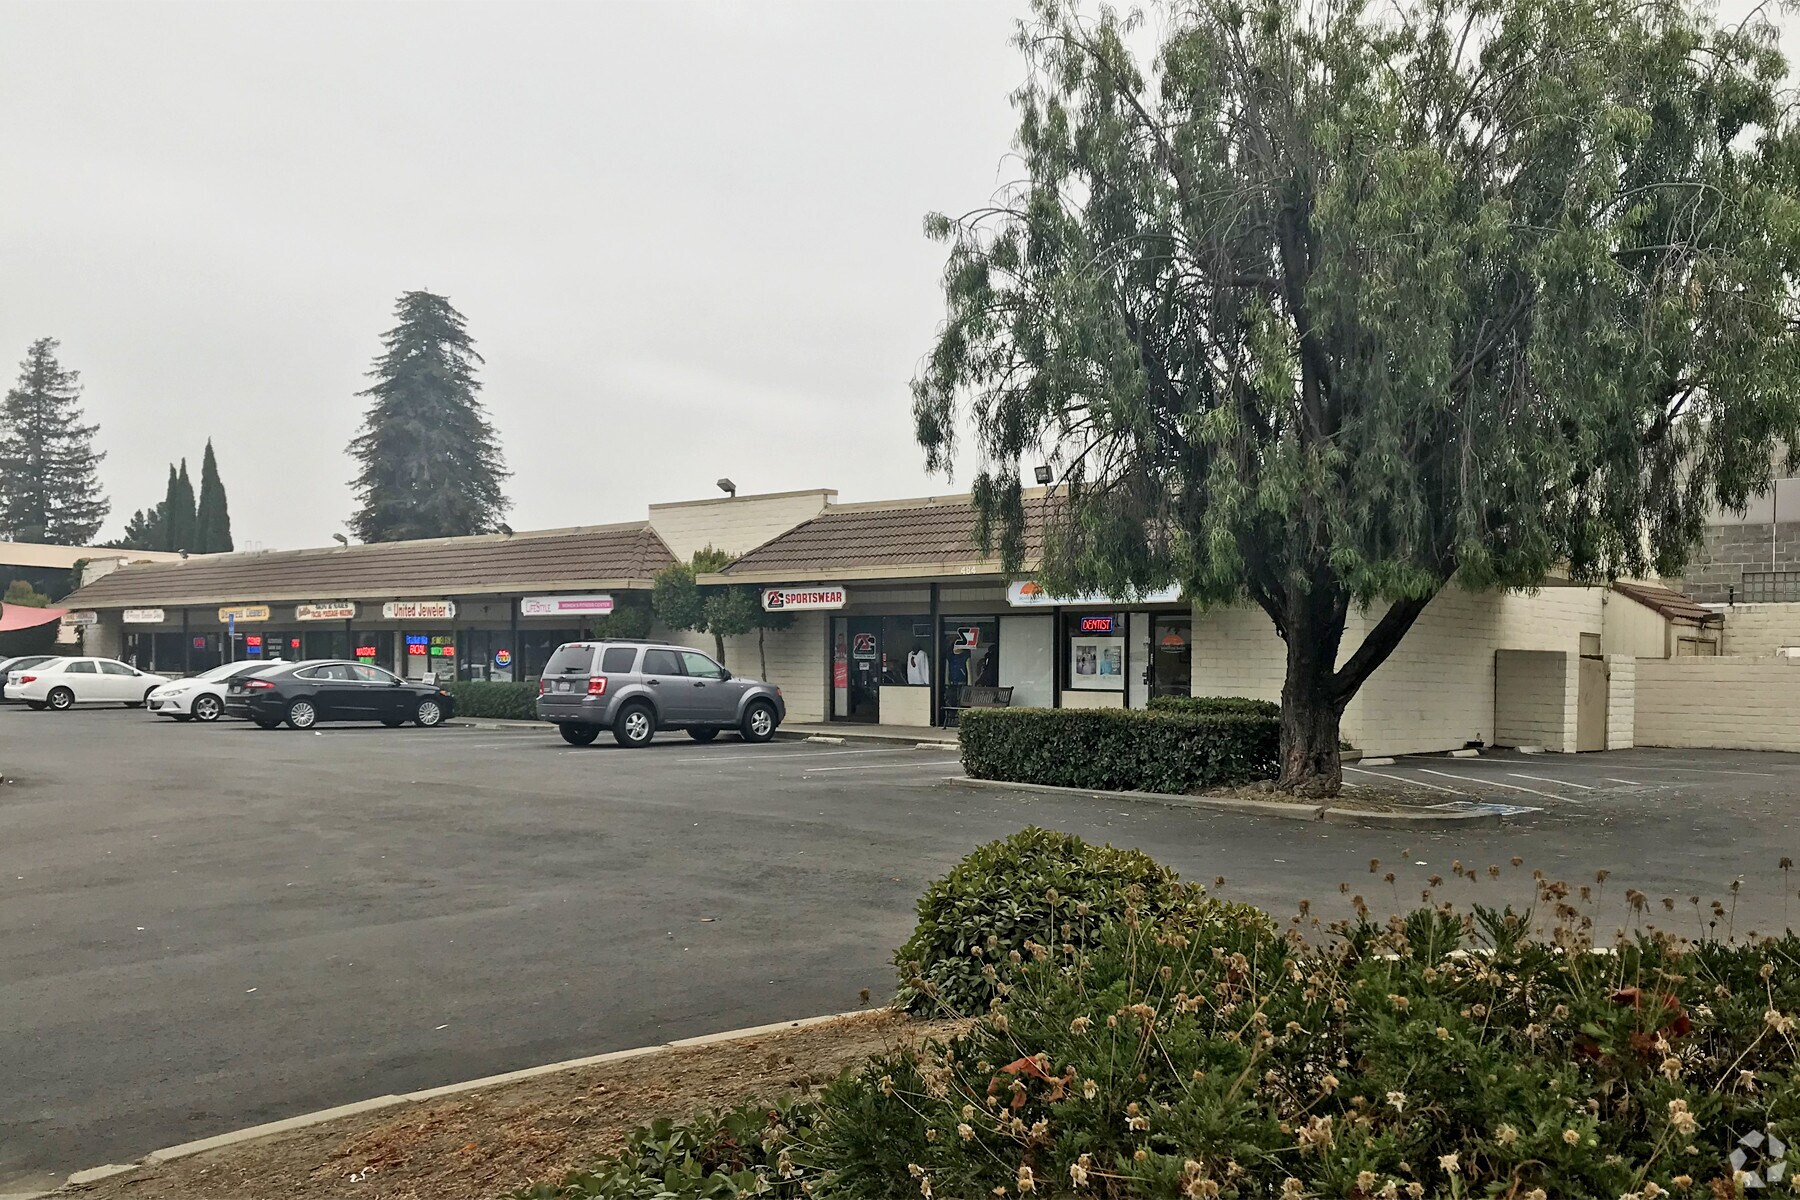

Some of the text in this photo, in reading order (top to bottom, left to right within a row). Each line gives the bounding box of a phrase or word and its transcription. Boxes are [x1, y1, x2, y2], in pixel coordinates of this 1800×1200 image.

[960, 566, 977, 575] 484
[785, 591, 842, 604] SPORTSWEAR
[394, 603, 416, 617] United
[418, 602, 446, 617] Jeweler
[1082, 619, 1111, 630] DENTIST
